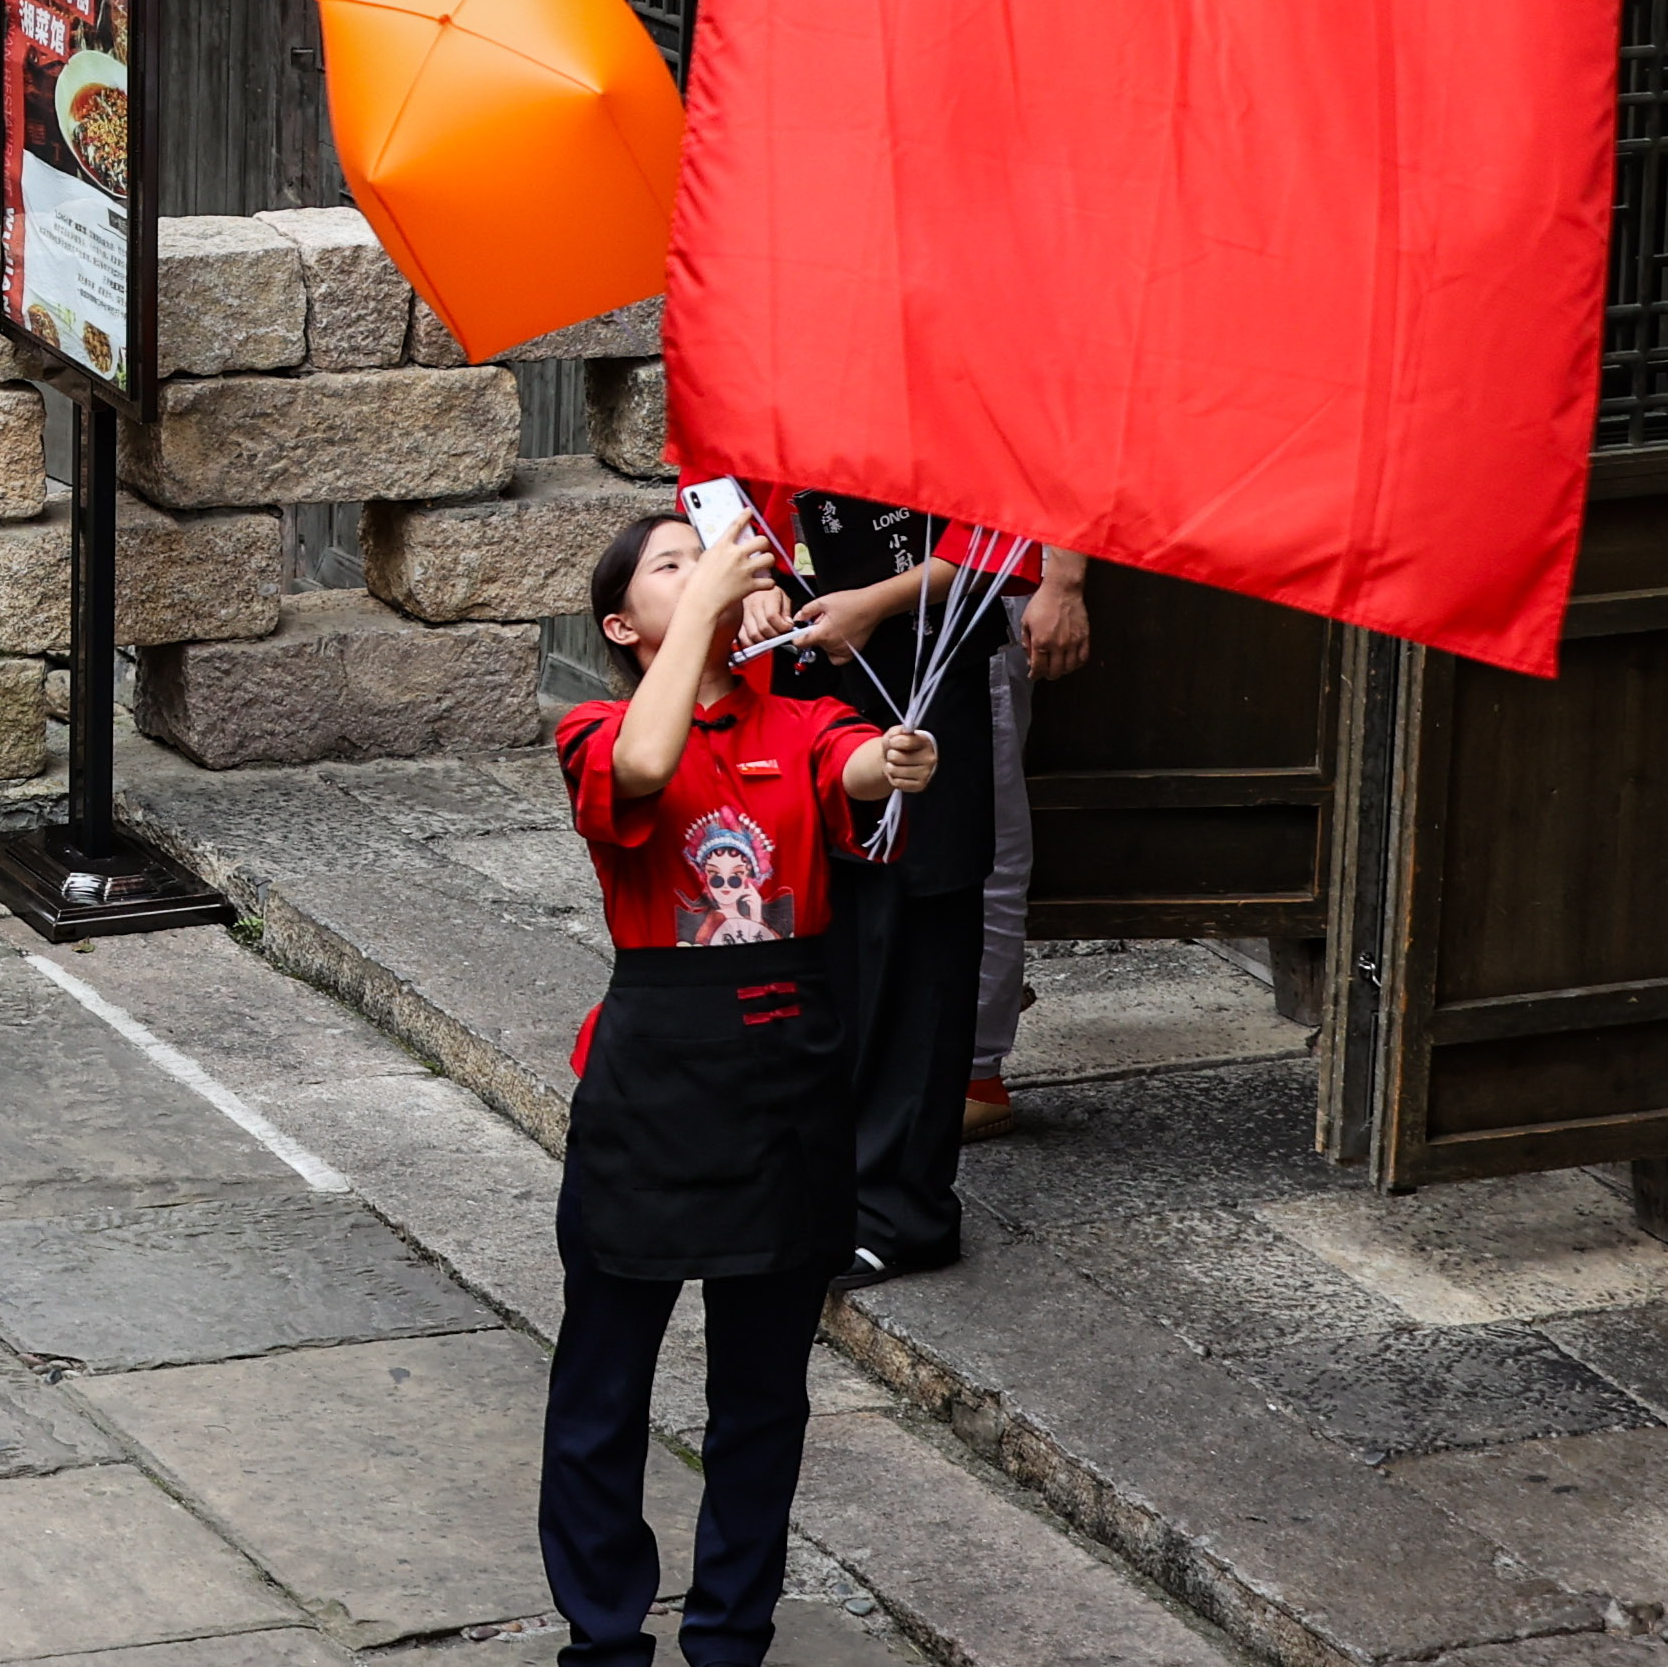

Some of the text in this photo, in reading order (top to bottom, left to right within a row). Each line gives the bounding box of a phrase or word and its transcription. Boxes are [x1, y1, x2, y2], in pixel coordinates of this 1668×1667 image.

[19, 0, 66, 56] 湘菜馆
[872, 507, 911, 532] LONG
